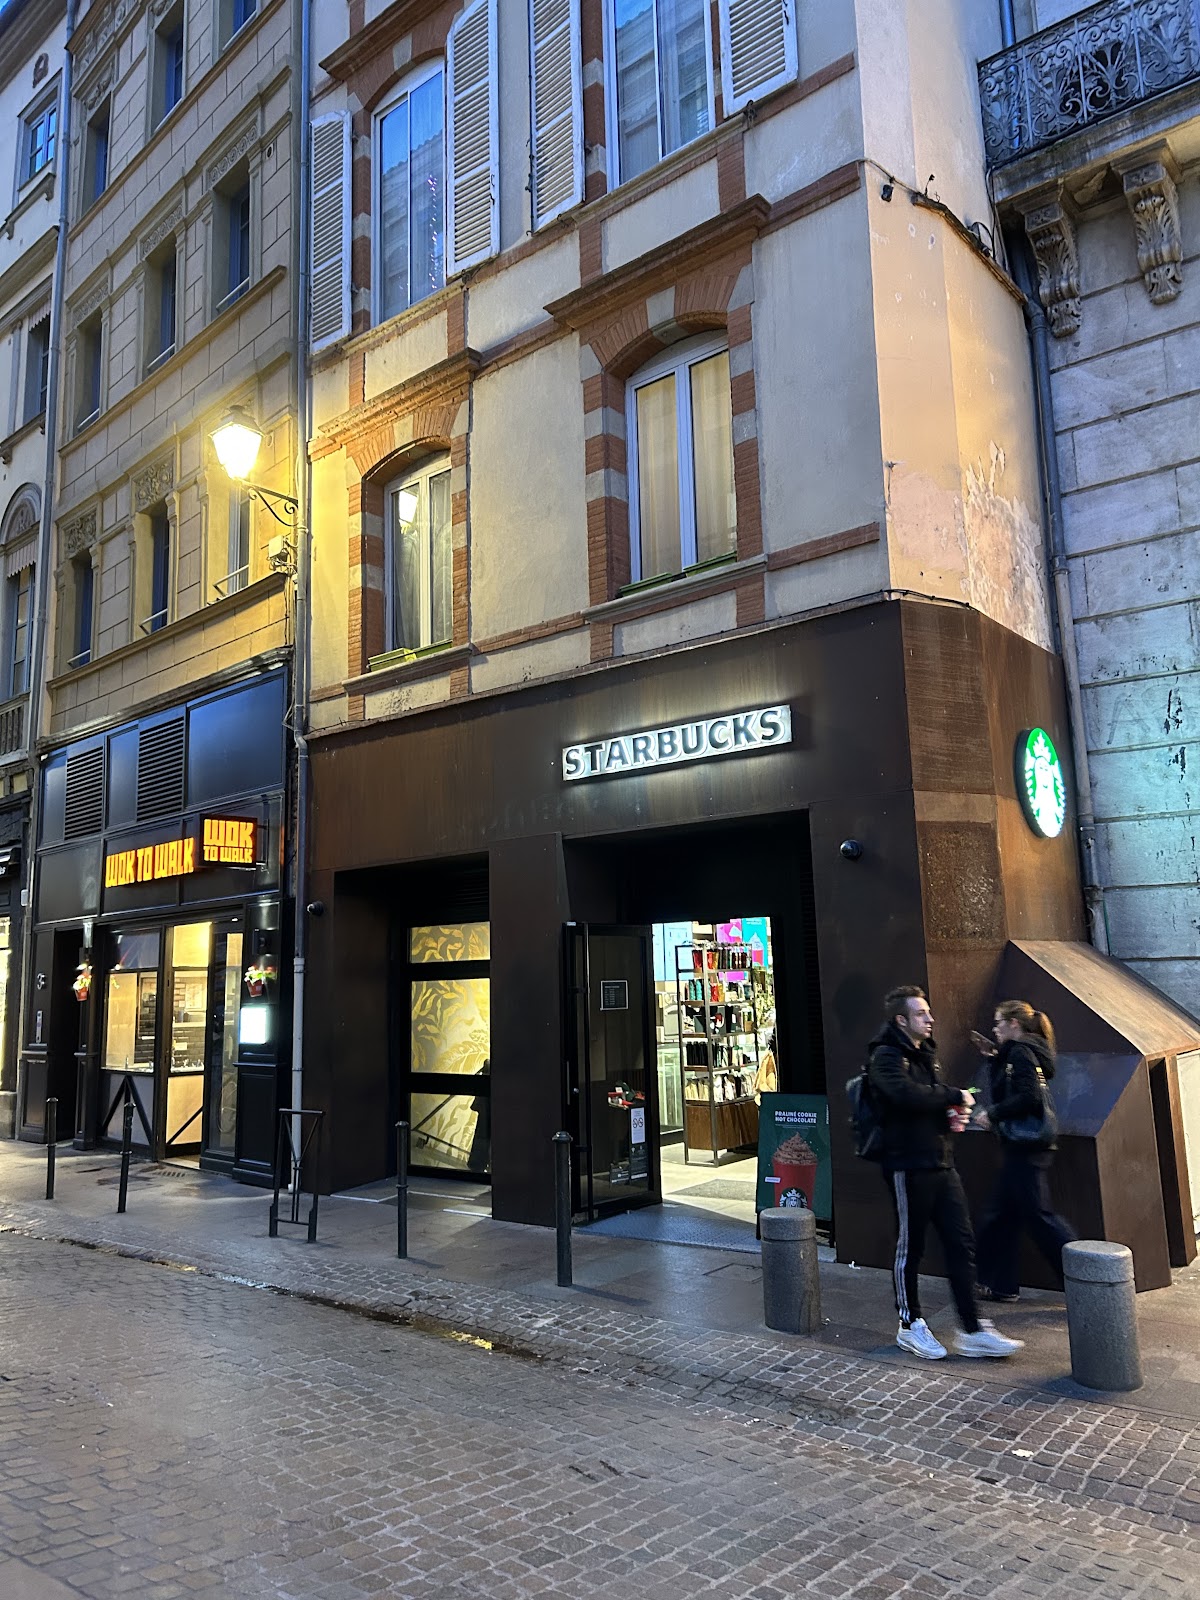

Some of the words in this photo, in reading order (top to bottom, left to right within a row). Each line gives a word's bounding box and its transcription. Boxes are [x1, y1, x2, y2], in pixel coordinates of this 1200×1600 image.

[564, 709, 784, 776] STARBUCKS
[204, 819, 254, 848] WOK
[105, 850, 136, 888] WOK
[136, 846, 153, 882] TO
[154, 837, 195, 879] WALK
[204, 846, 219, 862] TO
[219, 846, 253, 863] WALK
